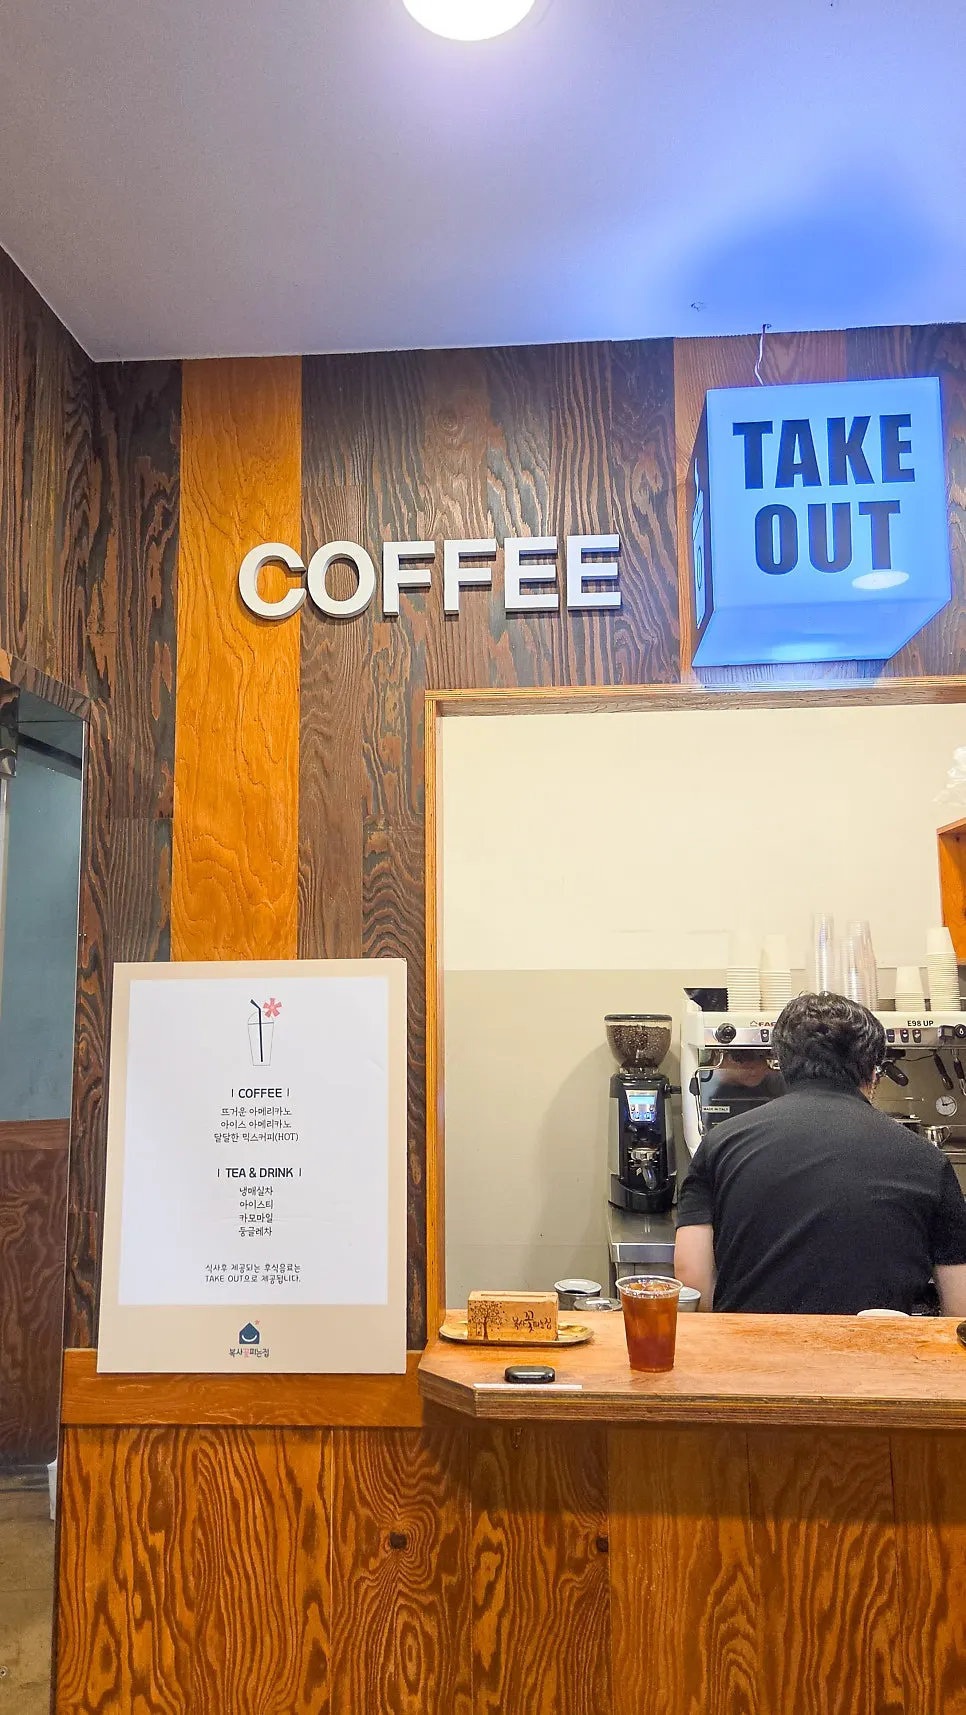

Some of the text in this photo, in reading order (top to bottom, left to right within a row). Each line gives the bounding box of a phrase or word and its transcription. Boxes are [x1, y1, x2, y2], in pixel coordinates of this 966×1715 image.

[732, 413, 916, 490] TAKE
[754, 501, 901, 575] OUT
[238, 533, 622, 621] COFFEE
[238, 1088, 282, 1098] COFFEE
[221, 1106, 292, 1117] 뜨거운 아메리카노
[220, 1119, 292, 1129] 아이스 아메리카노
[214, 1132, 299, 1143] 달달한 믹스커피(HOT)
[225, 1167, 294, 1178] TEA & DRINK
[240, 1186, 273, 1196] 냉매실차
[239, 1199, 273, 1209] 아이스티
[239, 1213, 273, 1223] 카모마일
[239, 1226, 272, 1237] 둥글레차
[205, 1264, 300, 1273] 식사후 제공되는 후식음료는
[205, 1275, 300, 1284] TAKE OUT으로 제공됩니다.
